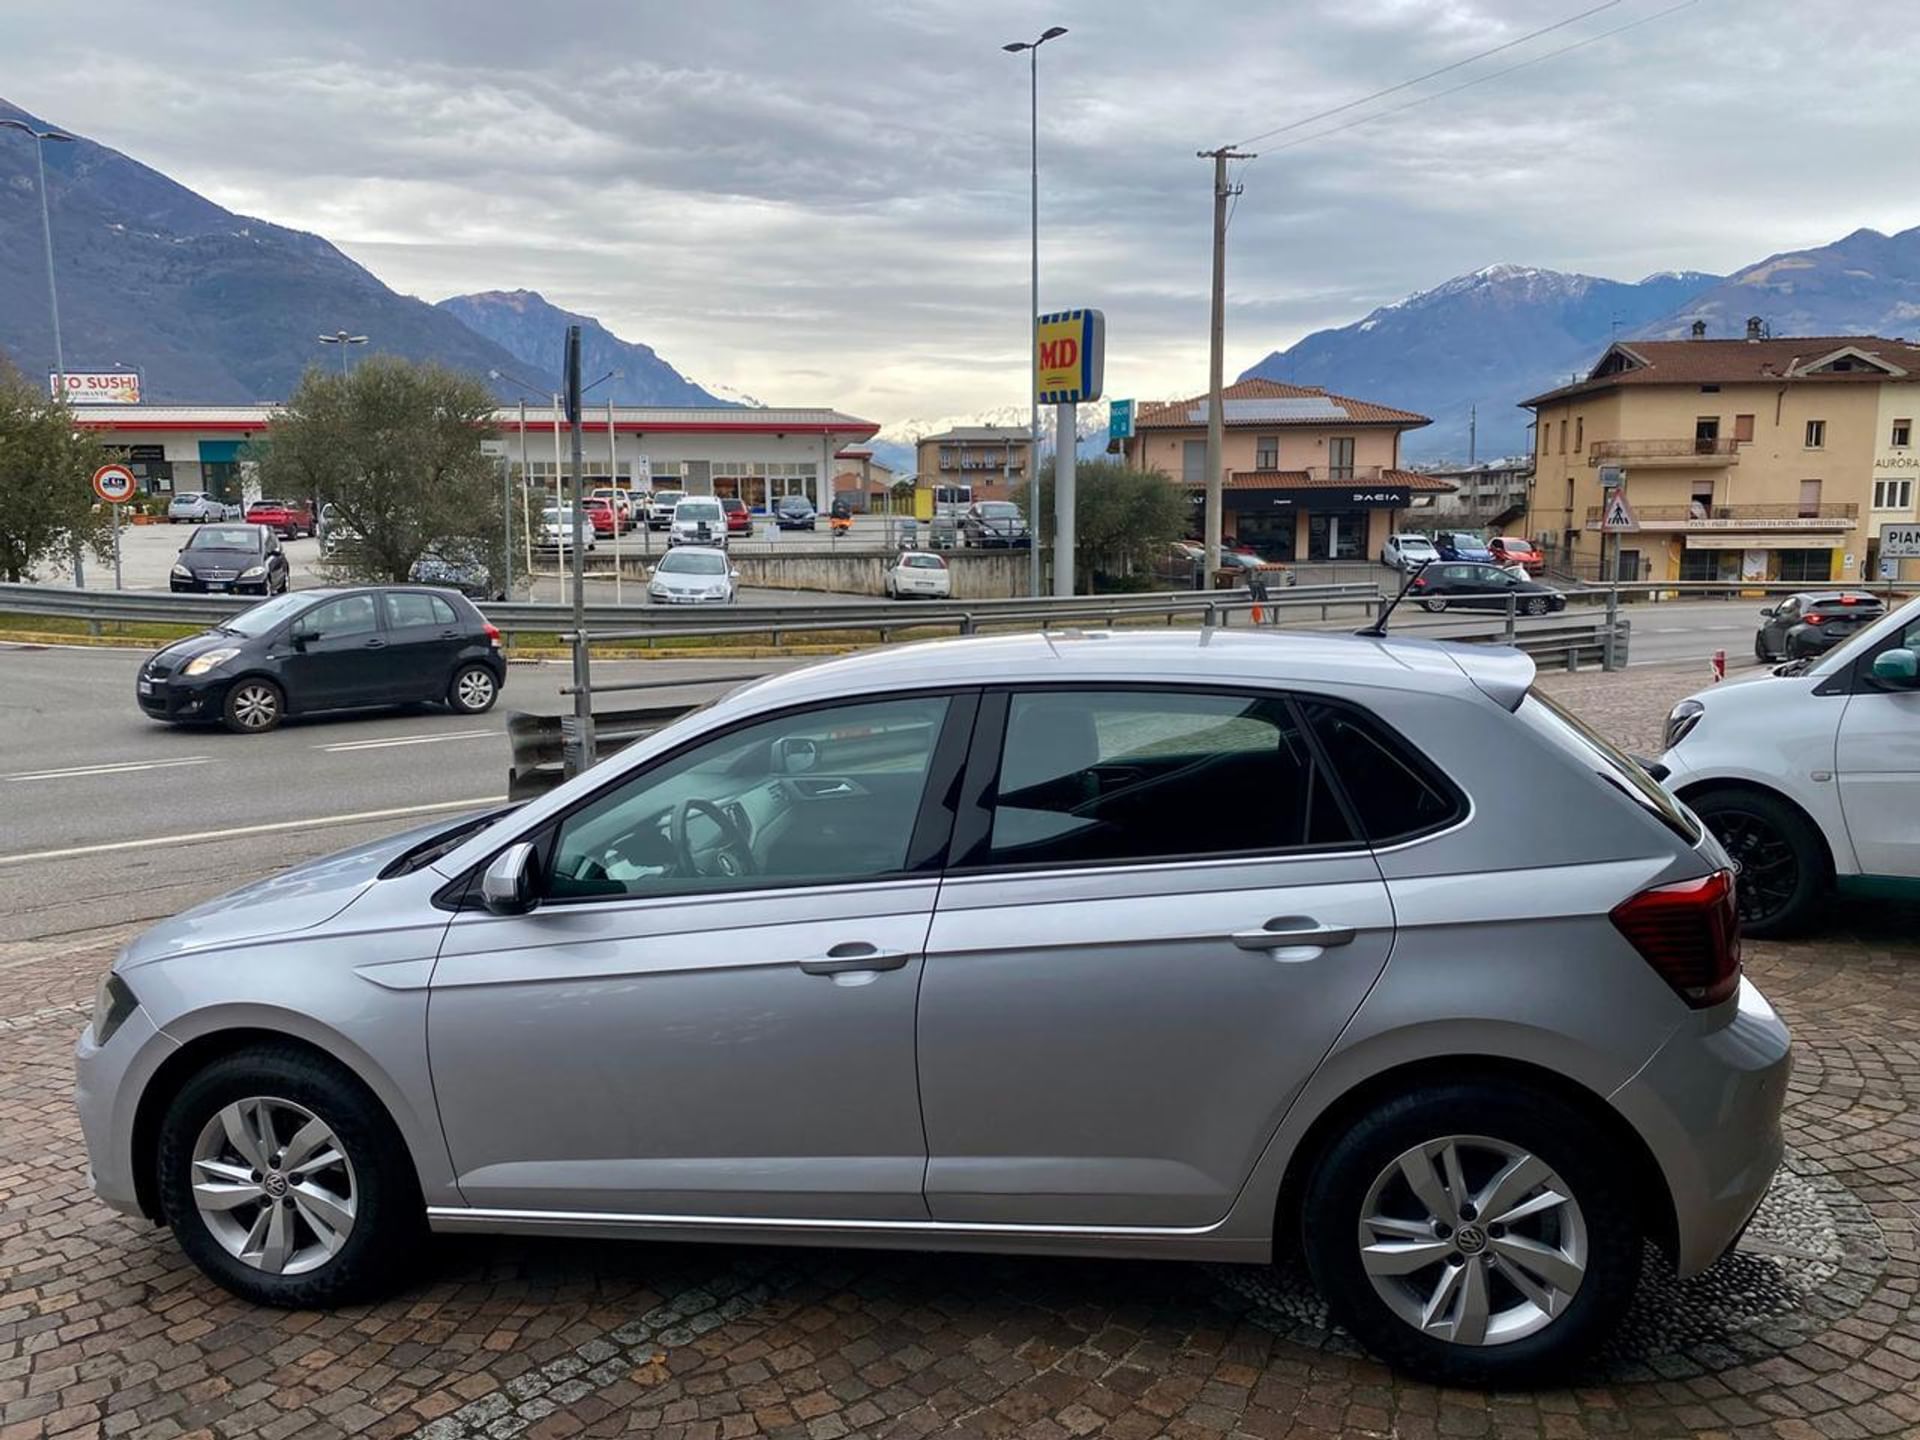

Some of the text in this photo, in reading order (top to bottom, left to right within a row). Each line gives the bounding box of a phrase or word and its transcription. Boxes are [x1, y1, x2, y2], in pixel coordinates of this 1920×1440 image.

[1039, 338, 1077, 371] MD
[87, 376, 136, 389] SUSHI
[1873, 458, 1920, 469] AURORA
[1353, 493, 1400, 502] DACIA
